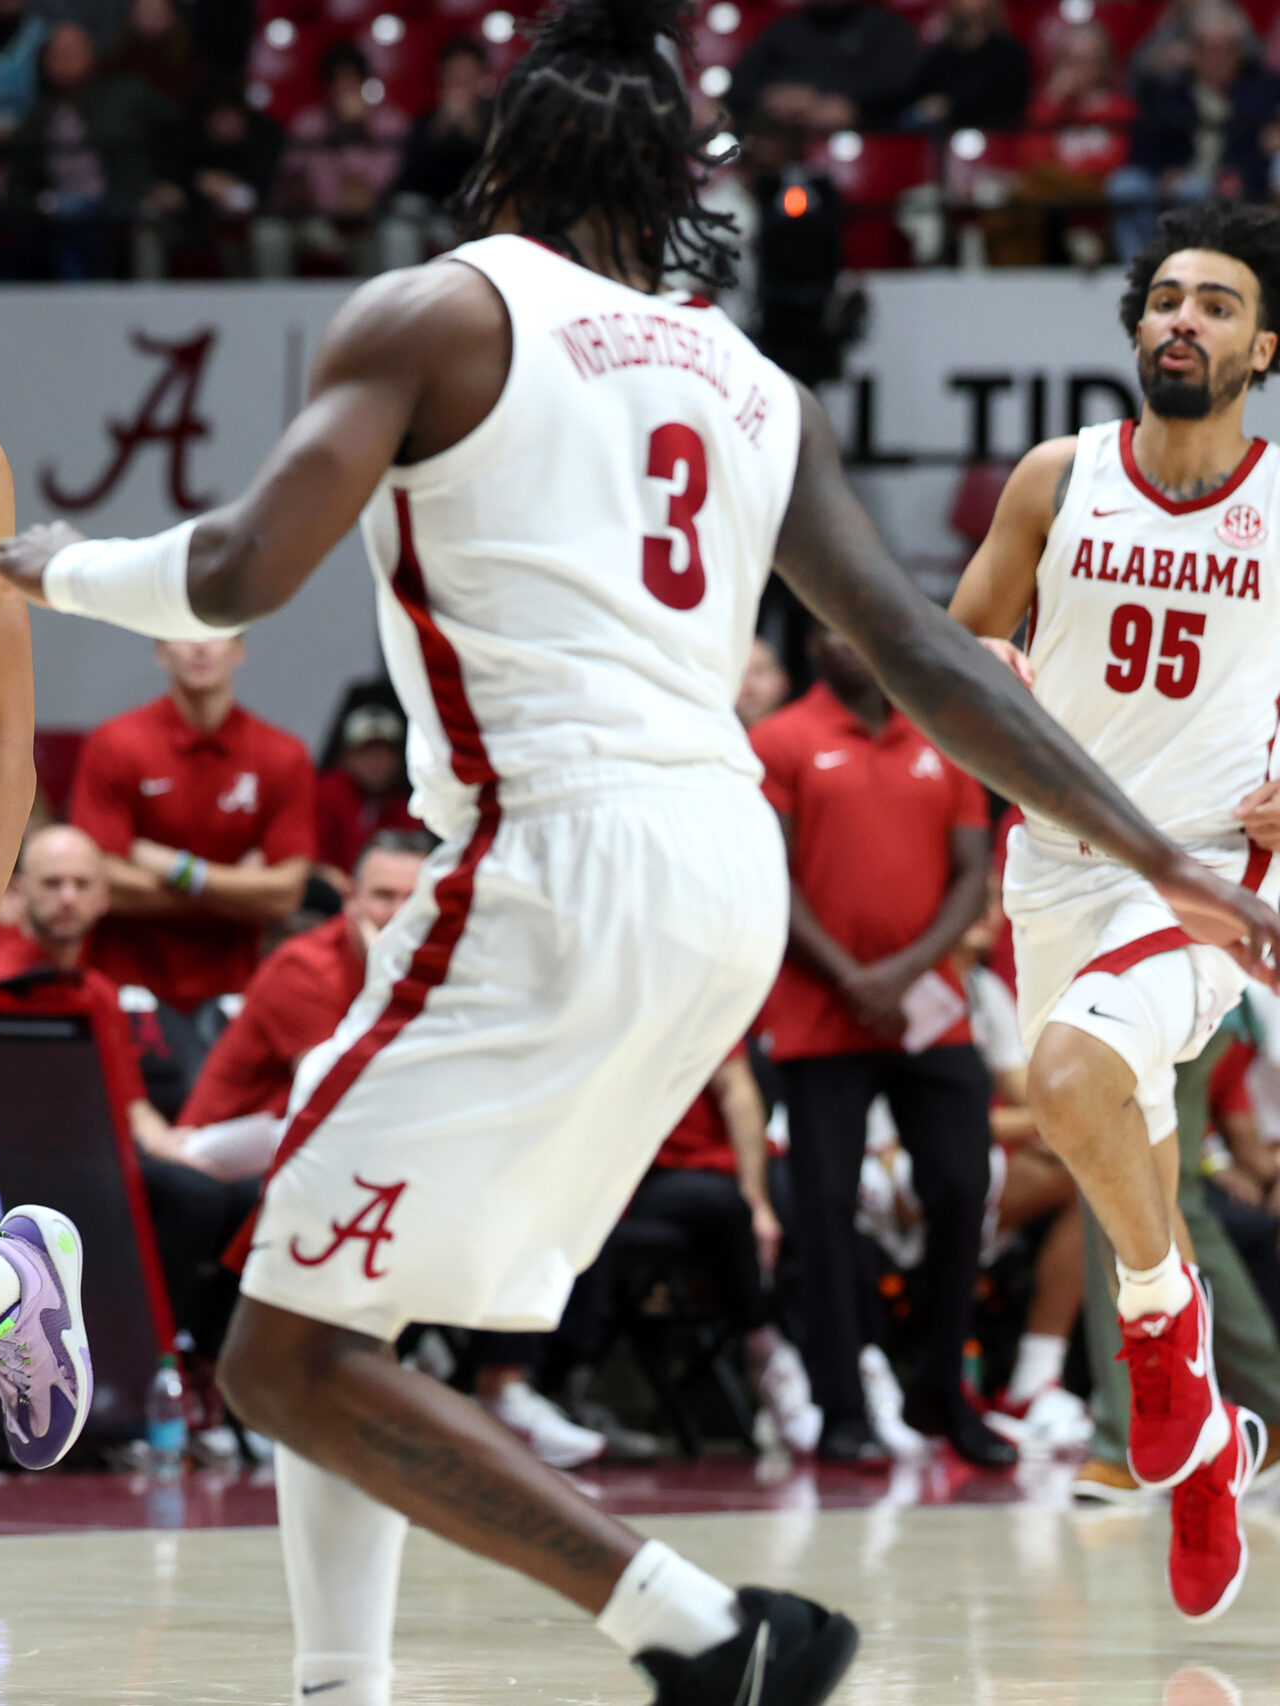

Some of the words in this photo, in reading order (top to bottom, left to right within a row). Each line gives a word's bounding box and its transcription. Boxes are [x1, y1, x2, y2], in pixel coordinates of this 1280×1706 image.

[951, 372, 1140, 463] TID
[642, 422, 708, 611] 3
[1070, 537, 1261, 601] ALABAMA
[1104, 603, 1207, 700] 95
